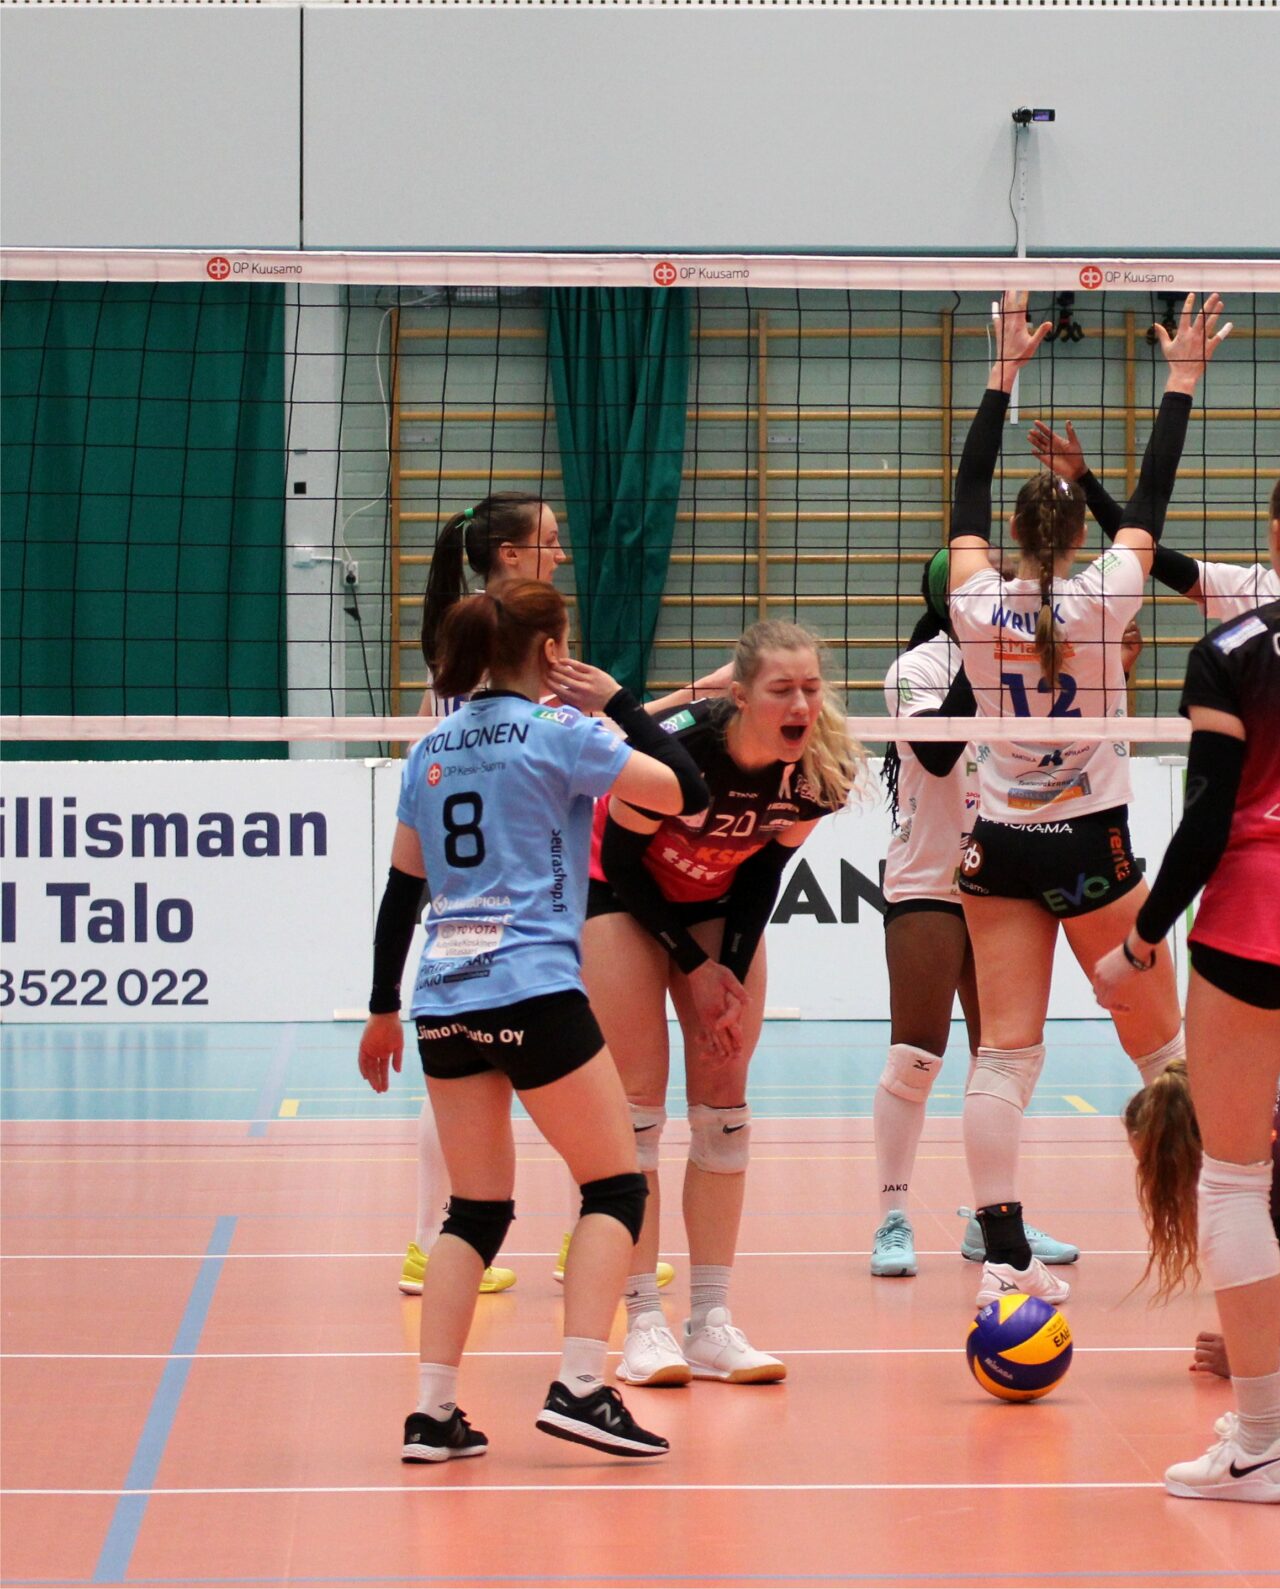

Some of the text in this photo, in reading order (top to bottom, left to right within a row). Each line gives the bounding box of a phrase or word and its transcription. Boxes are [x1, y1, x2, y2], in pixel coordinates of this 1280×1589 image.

[233, 262, 303, 275] OP Kuusamo
[680, 267, 750, 279] OP Kuusamo
[1105, 271, 1174, 283] OP Kuusamo
[1000, 672, 1083, 717] 12
[443, 791, 486, 868] 8
[709, 810, 757, 837] 20
[1042, 873, 1110, 912] EVO
[46, 882, 194, 943] Talo
[457, 924, 498, 935] TOYOTA
[117, 968, 209, 1007] 022
[467, 1029, 494, 1044] uto
[499, 1028, 525, 1046] Oy
[882, 1183, 909, 1193] JAKO
